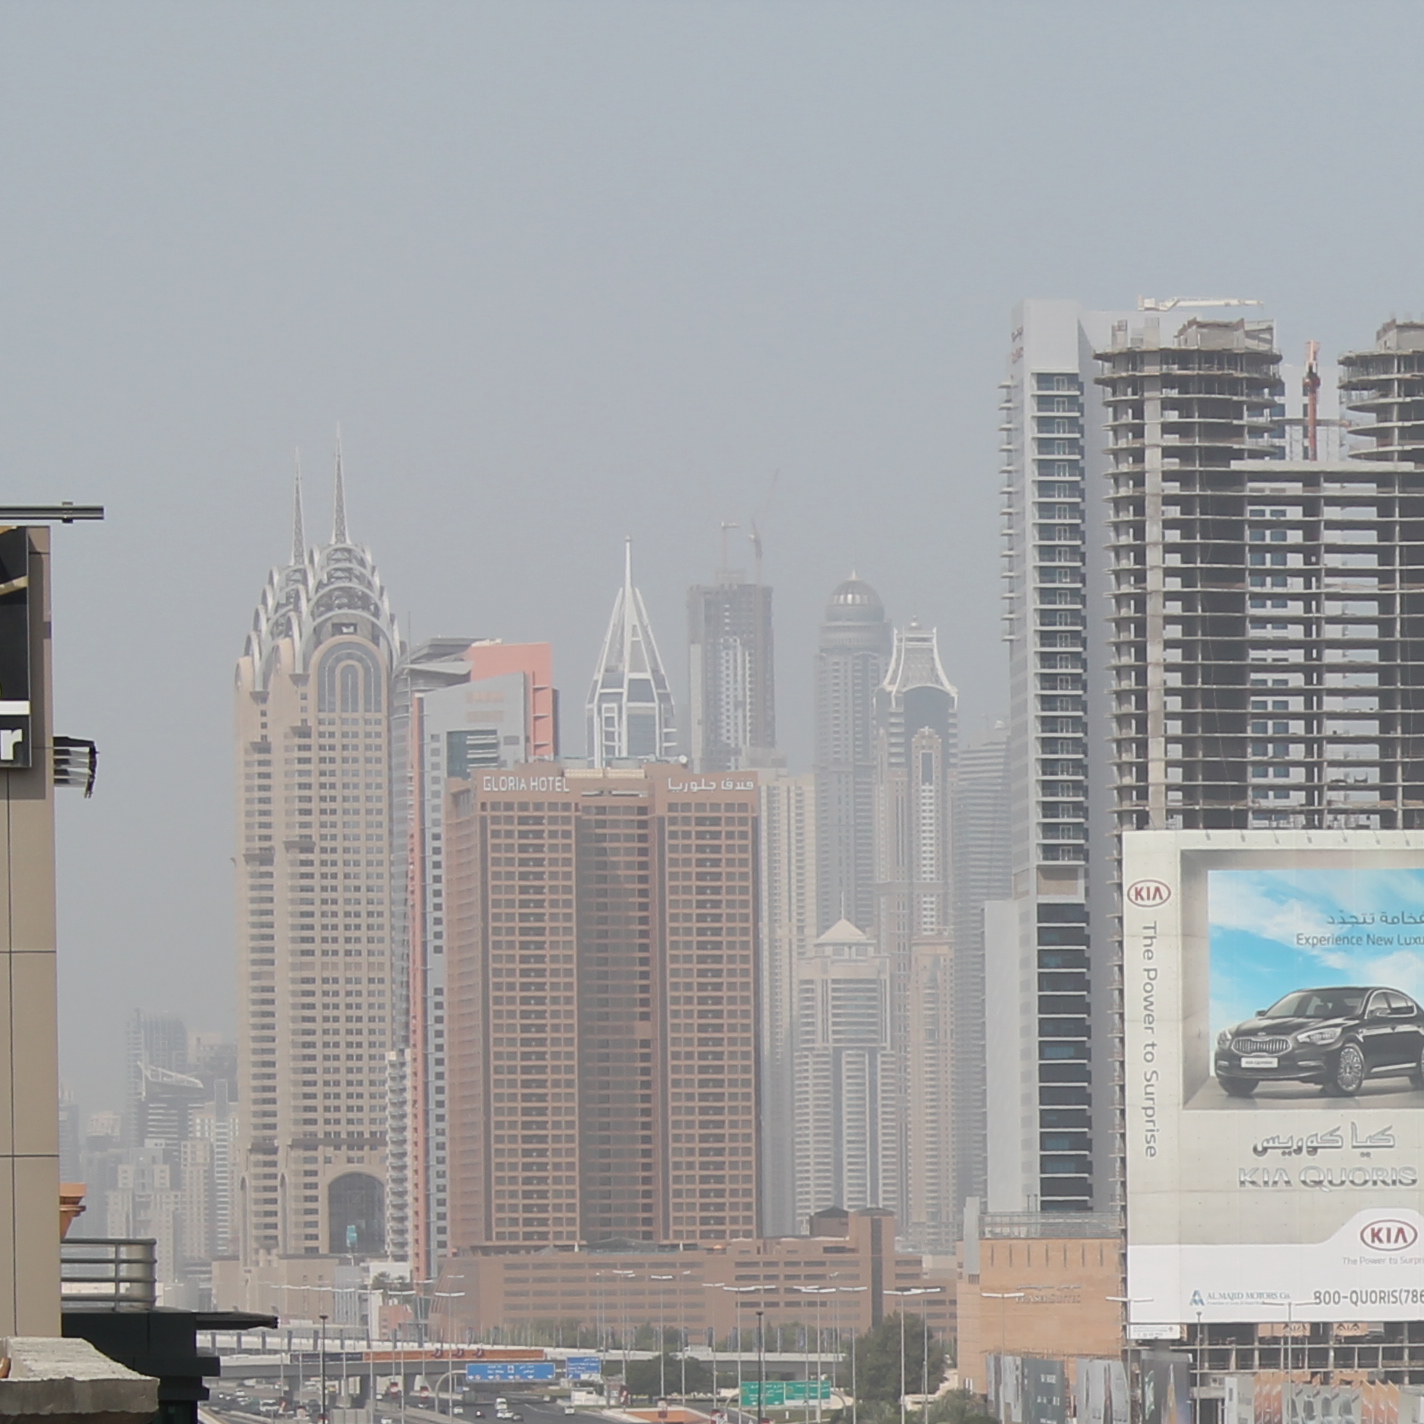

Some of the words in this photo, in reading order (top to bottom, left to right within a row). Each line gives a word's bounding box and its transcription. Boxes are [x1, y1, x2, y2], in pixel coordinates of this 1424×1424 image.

[483, 776, 526, 791] GLORIA
[530, 776, 570, 792] HOTEL
[721, 778, 754, 790] فندق
[1134, 886, 1164, 902] KIA
[1142, 920, 1157, 961] The
[1296, 934, 1364, 948] Experience
[1366, 934, 1393, 946] New
[1142, 968, 1158, 1034] Power
[1143, 1041, 1157, 1063] to
[1141, 1069, 1160, 1158] Surprise
[1350, 1121, 1396, 1158] كيا
[1238, 1168, 1293, 1187] KIA
[1299, 1166, 1418, 1192] QUORIS
[1370, 1226, 1409, 1245] KIA
[1342, 1256, 1358, 1265] The
[1360, 1257, 1386, 1265] Power
[1389, 1257, 1398, 1265] to
